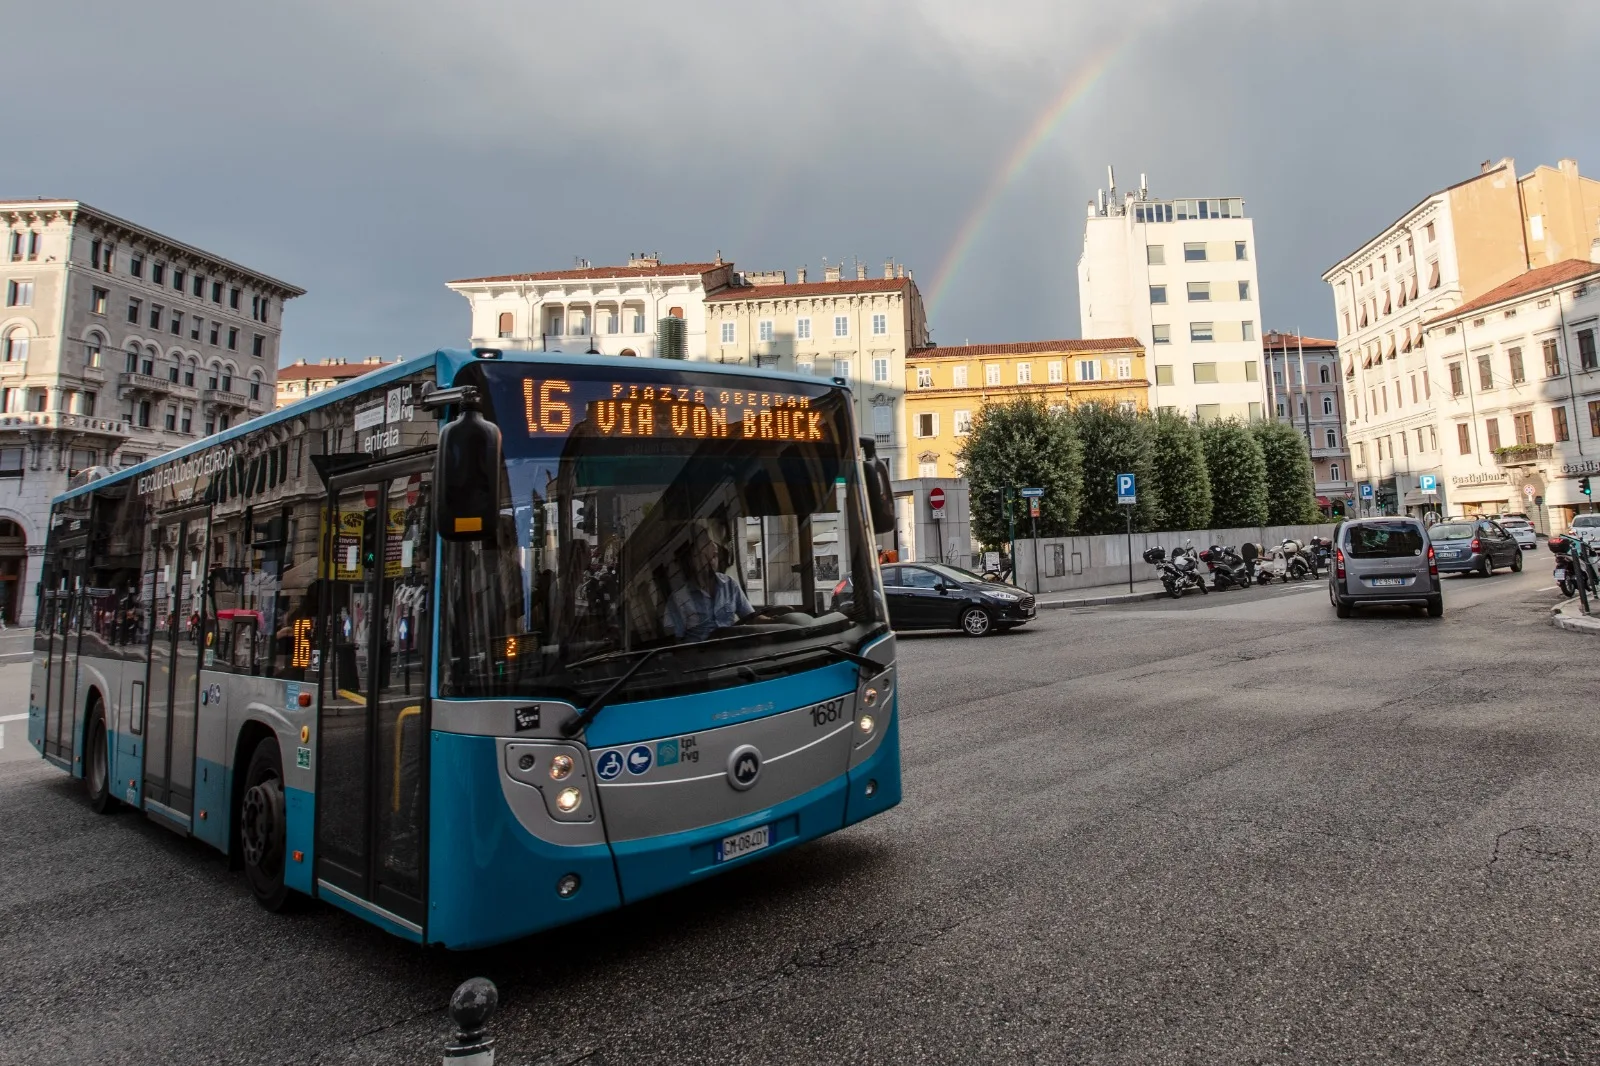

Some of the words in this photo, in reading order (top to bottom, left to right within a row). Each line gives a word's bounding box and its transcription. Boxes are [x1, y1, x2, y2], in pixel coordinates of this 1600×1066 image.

[401, 383, 413, 404] tpl
[612, 384, 705, 403] PIAZZA
[719, 391, 810, 409] OBERDAN
[400, 404, 414, 422] fvg
[522, 378, 572, 433] 16
[597, 401, 654, 435] VIA
[671, 404, 728, 437] VON
[742, 408, 822, 440] BRUCK
[364, 426, 399, 453] entrata
[137, 471, 163, 496] VEICOLO
[162, 457, 203, 488] ECOLOGICO
[204, 449, 227, 476] EURO
[227, 446, 235, 468] 6
[1423, 476, 1434, 489] P
[1120, 476, 1132, 495] P
[1363, 486, 1371, 496] P
[292, 619, 312, 668] 16
[809, 697, 845, 728] 1687
[681, 735, 697, 749] tpl
[681, 748, 700, 763] fvg
